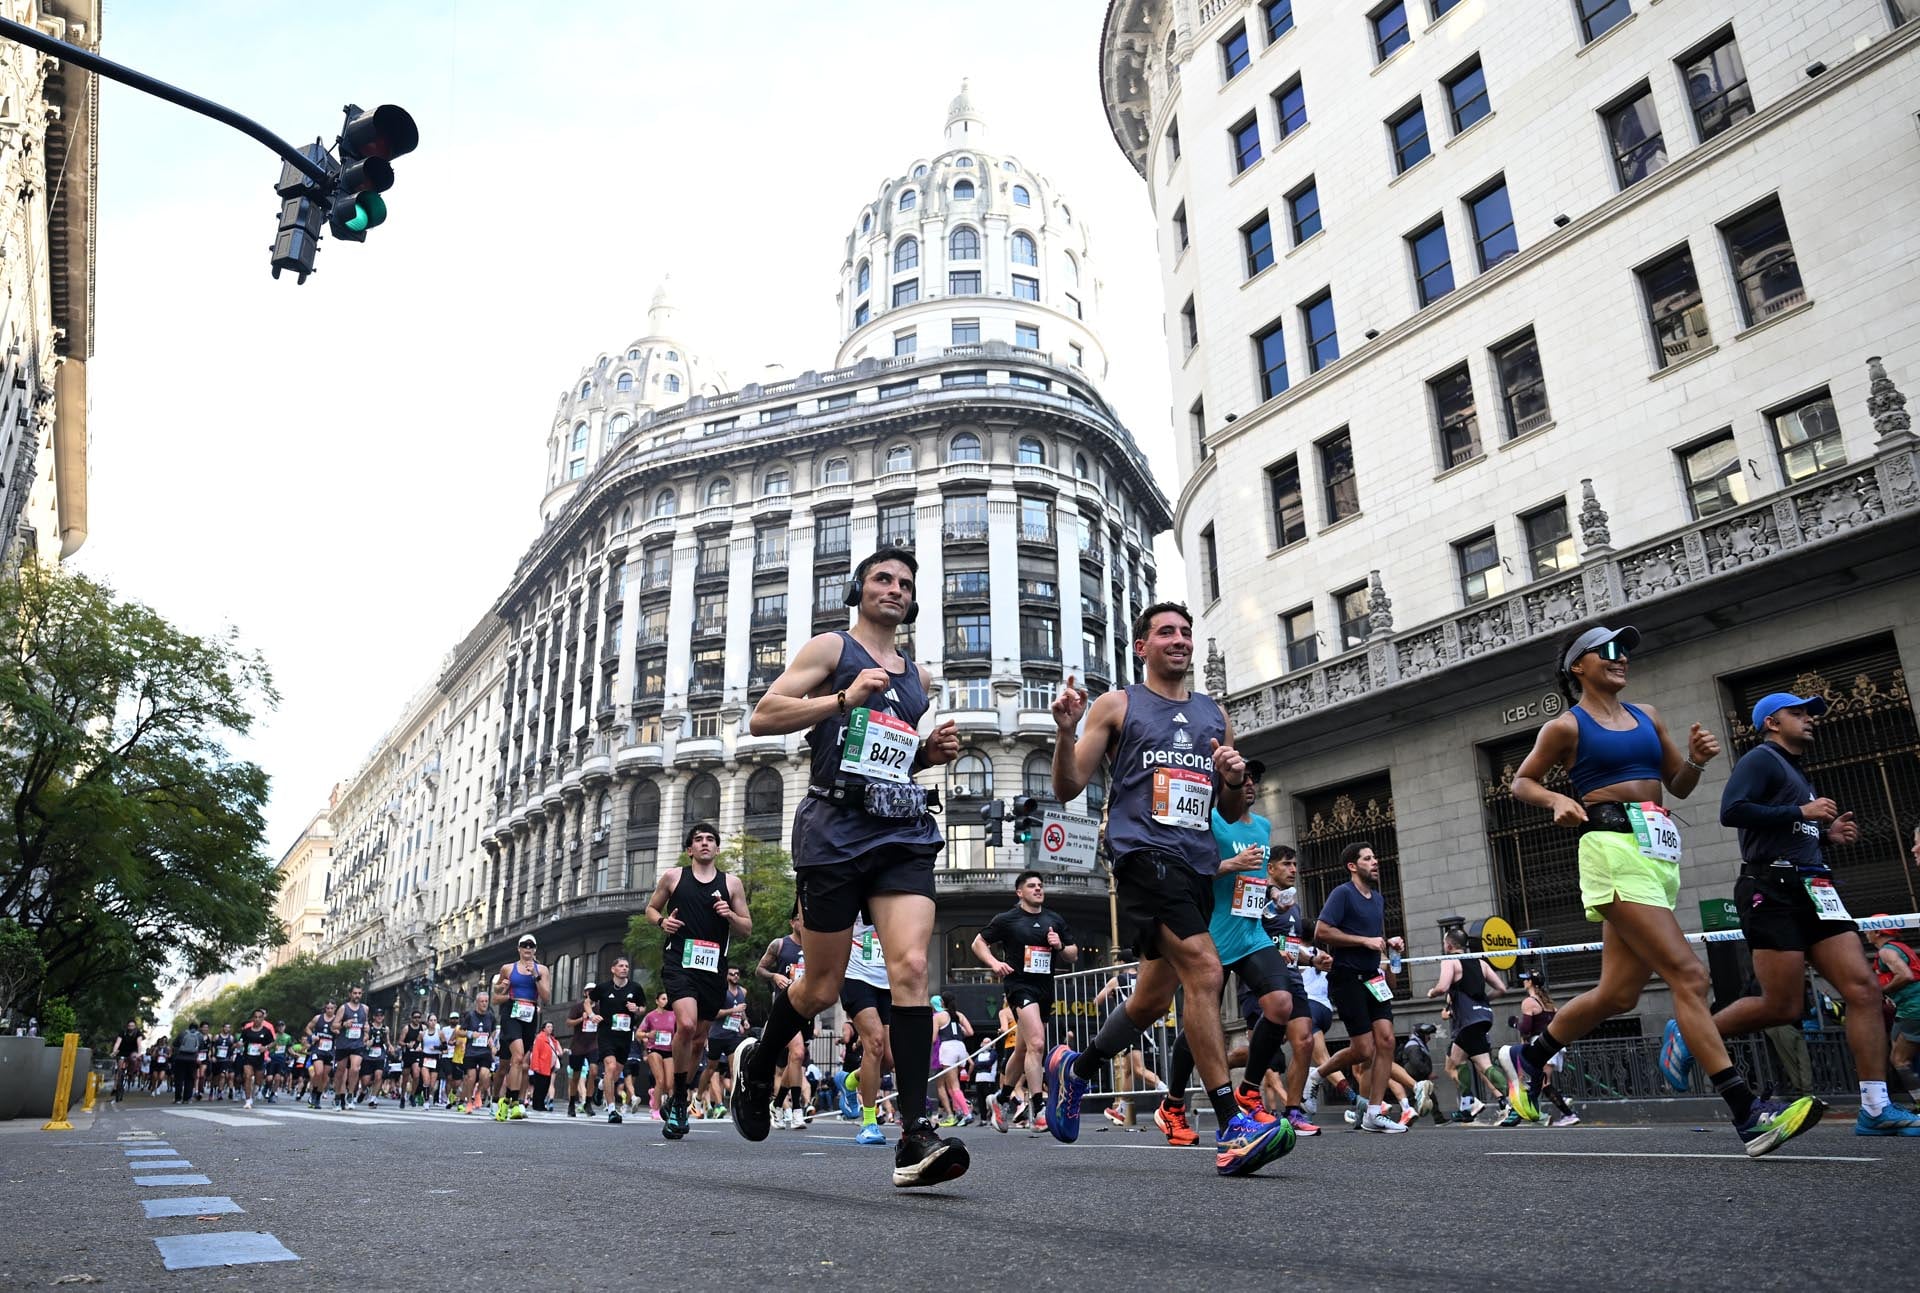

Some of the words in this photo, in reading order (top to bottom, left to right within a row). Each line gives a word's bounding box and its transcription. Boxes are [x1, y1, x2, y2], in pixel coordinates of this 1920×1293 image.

[1503, 702, 1538, 724] ICBC
[855, 715, 863, 727] E
[883, 731, 914, 746] JONATHAN
[870, 743, 906, 769] 8472
[1158, 774, 1165, 786] D
[1184, 784, 1209, 796] LEONARDO
[1176, 796, 1205, 817] 4451
[1061, 814, 1098, 827] MICROCENTRO
[1654, 827, 1678, 849] 7486
[1058, 857, 1083, 865] INGRESAR
[1246, 895, 1265, 909] 518
[1861, 918, 1905, 930] ANDU
[1485, 933, 1514, 948] Subte
[694, 954, 714, 967] 6411
